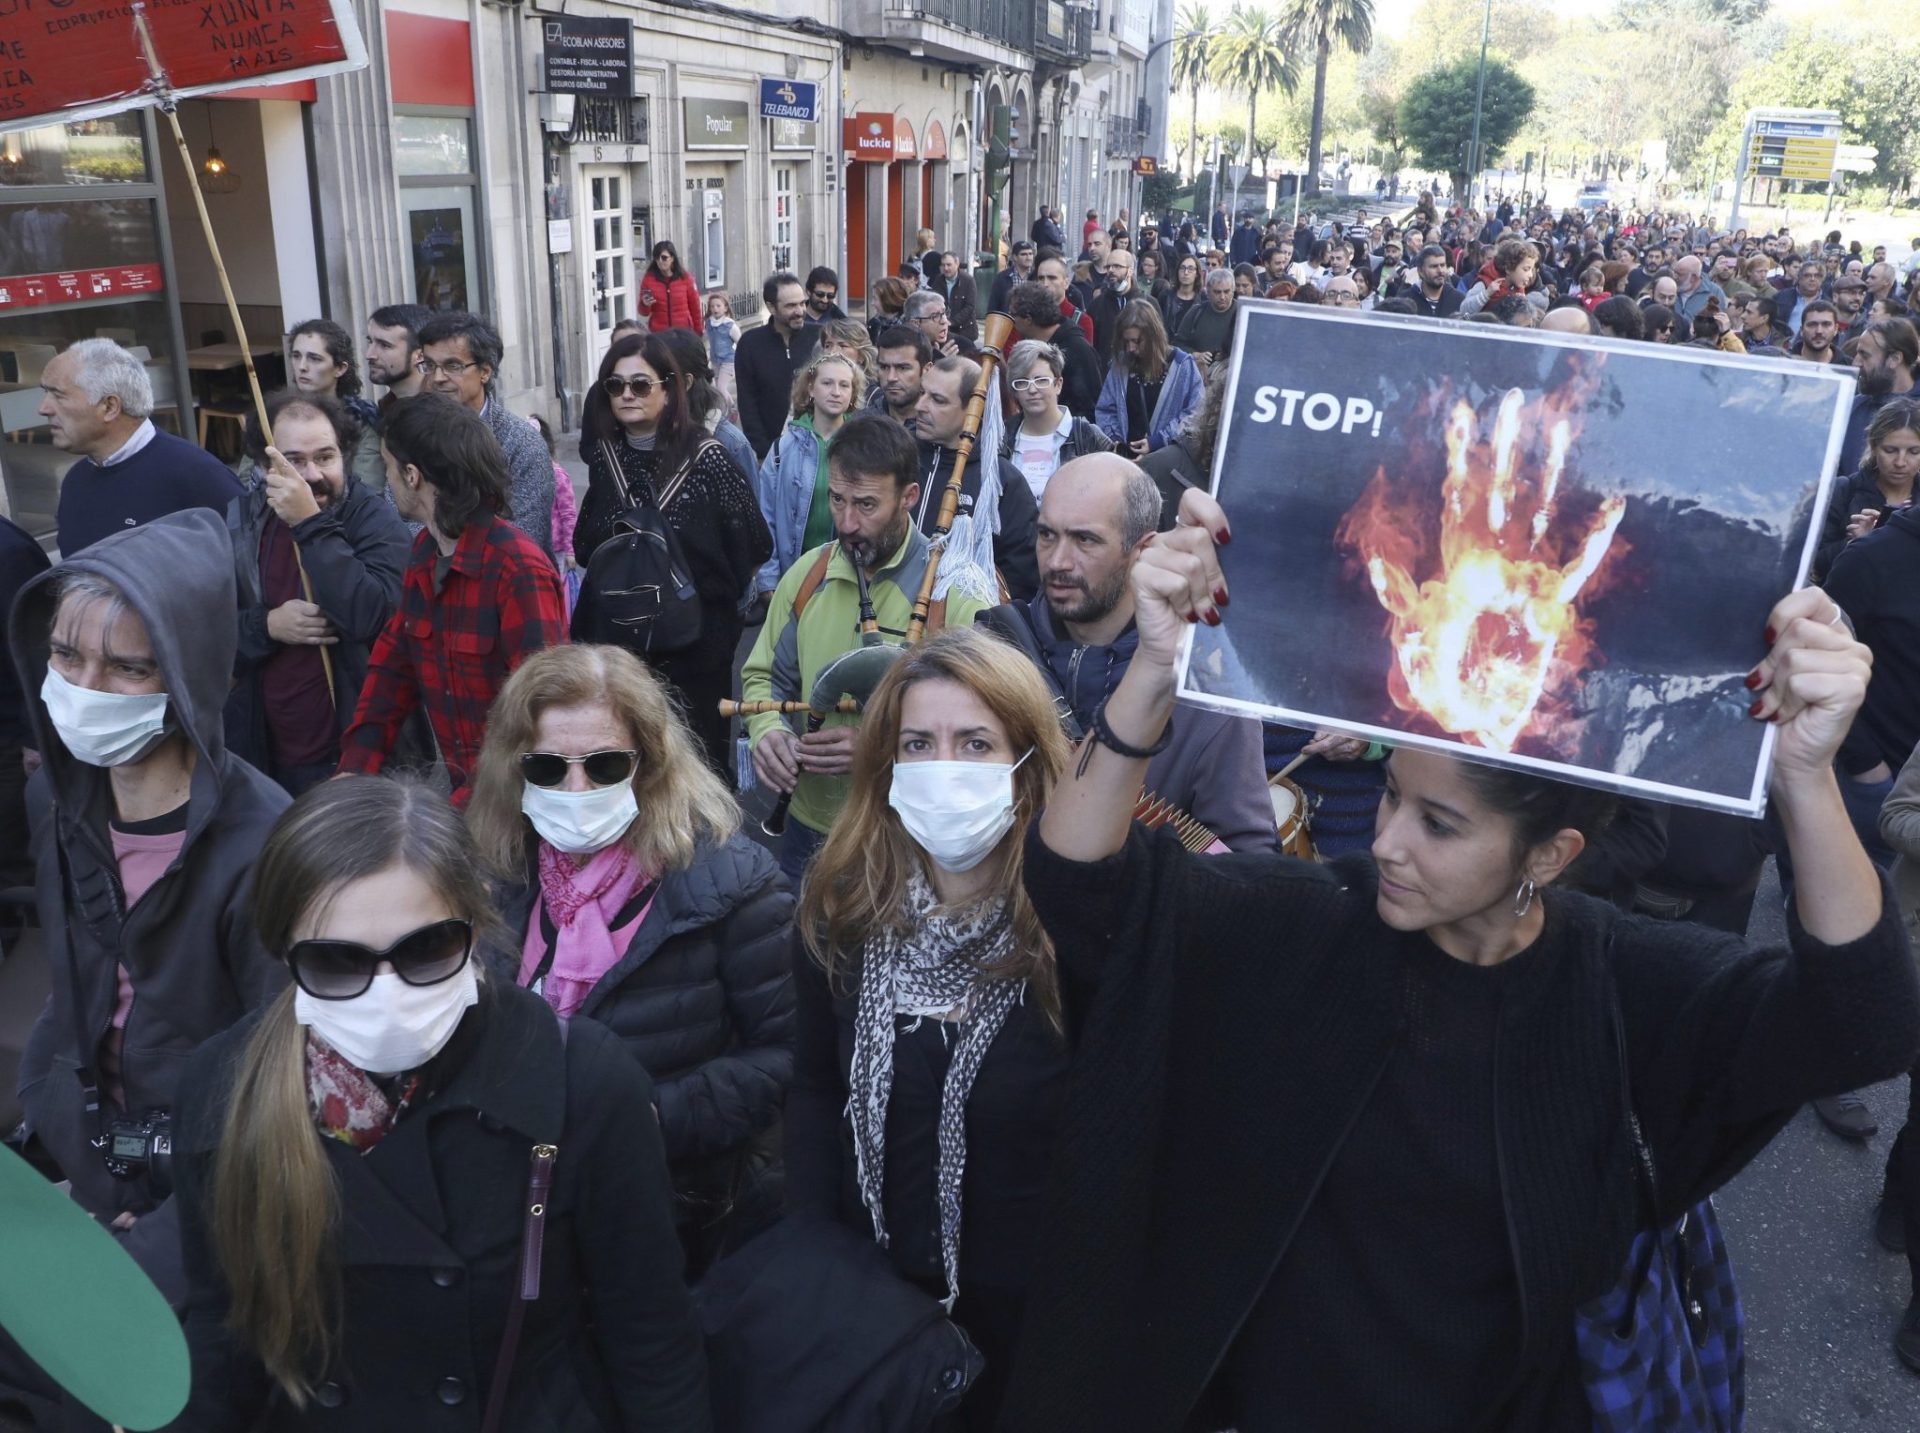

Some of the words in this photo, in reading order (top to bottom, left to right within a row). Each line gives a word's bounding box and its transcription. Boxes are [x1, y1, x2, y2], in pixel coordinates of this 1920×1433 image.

[211, 21, 296, 51] NUNCA
[562, 36, 593, 48] ECOBLAN
[593, 37, 626, 49] ASESORES
[230, 48, 293, 72] MAIS
[549, 57, 577, 66] CONTABLE
[580, 58, 599, 67] FISCAL
[602, 59, 627, 67] LABORAL
[576, 70, 618, 78] ADMINISTRATIVA
[550, 80, 575, 88] SEGUROS
[576, 81, 607, 89] GENERALES
[764, 103, 809, 118] TELEBANCO
[706, 115, 732, 135] Popular
[859, 136, 891, 149] luckia
[1250, 385, 1383, 437] STOP!
